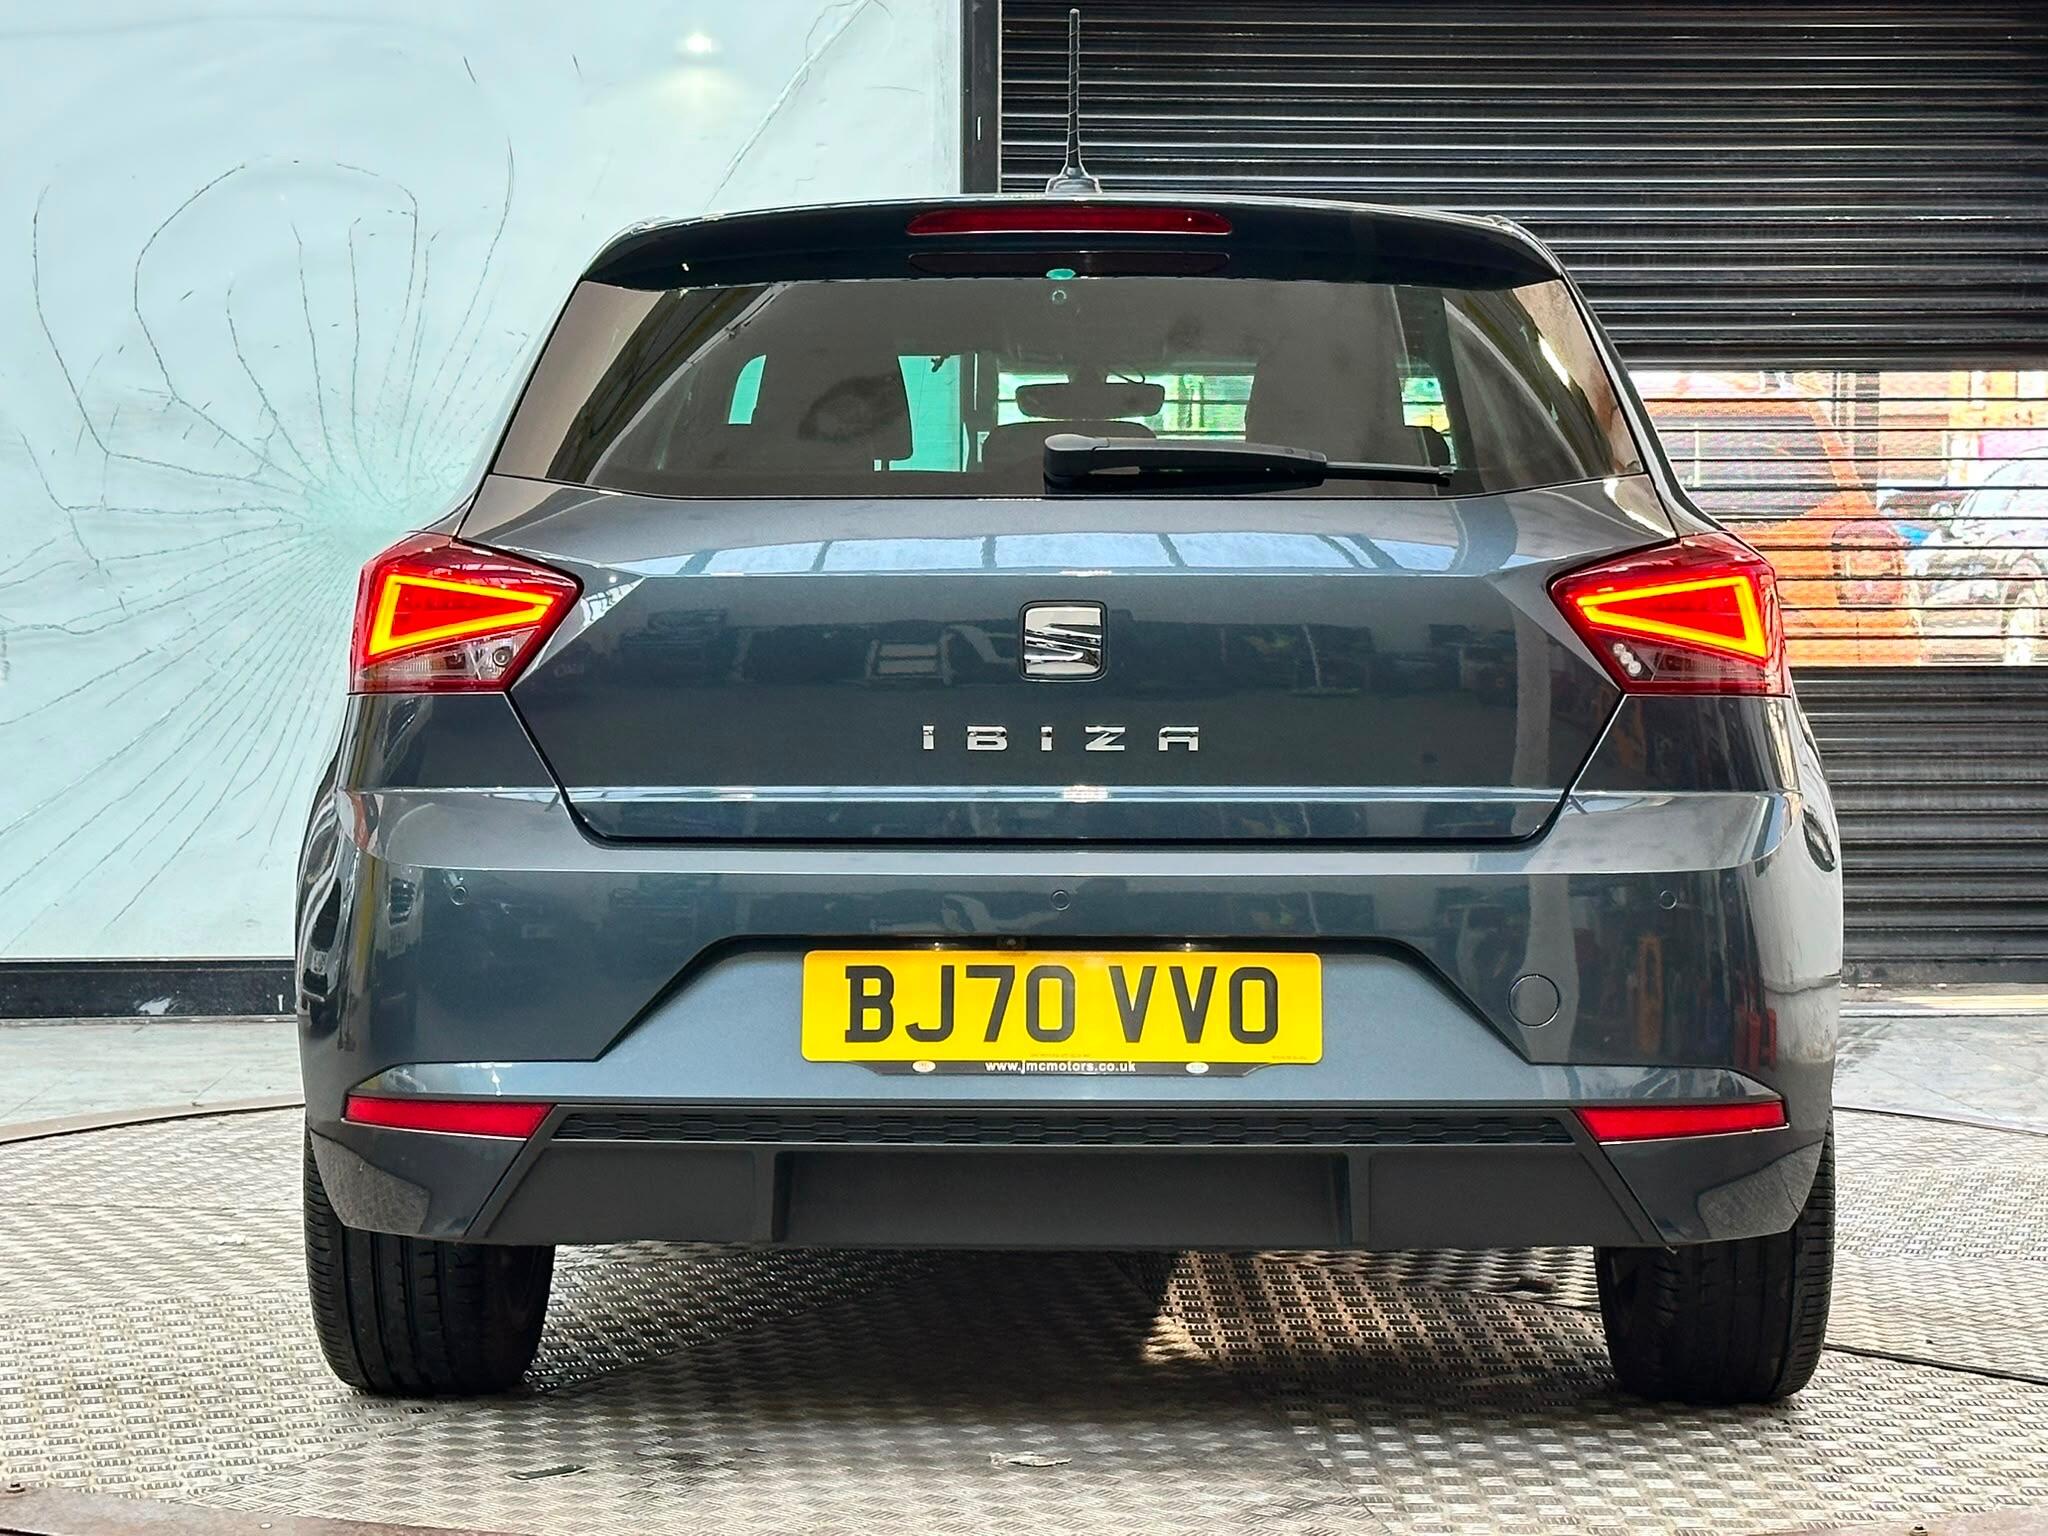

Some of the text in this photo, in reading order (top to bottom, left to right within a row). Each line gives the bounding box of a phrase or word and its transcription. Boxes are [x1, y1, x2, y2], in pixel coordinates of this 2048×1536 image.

[922, 725, 1200, 751] IBIZA
[844, 964, 1279, 1045] BJ70 VVO
[984, 1060, 1137, 1074] www.jmcmotors.co.uk
